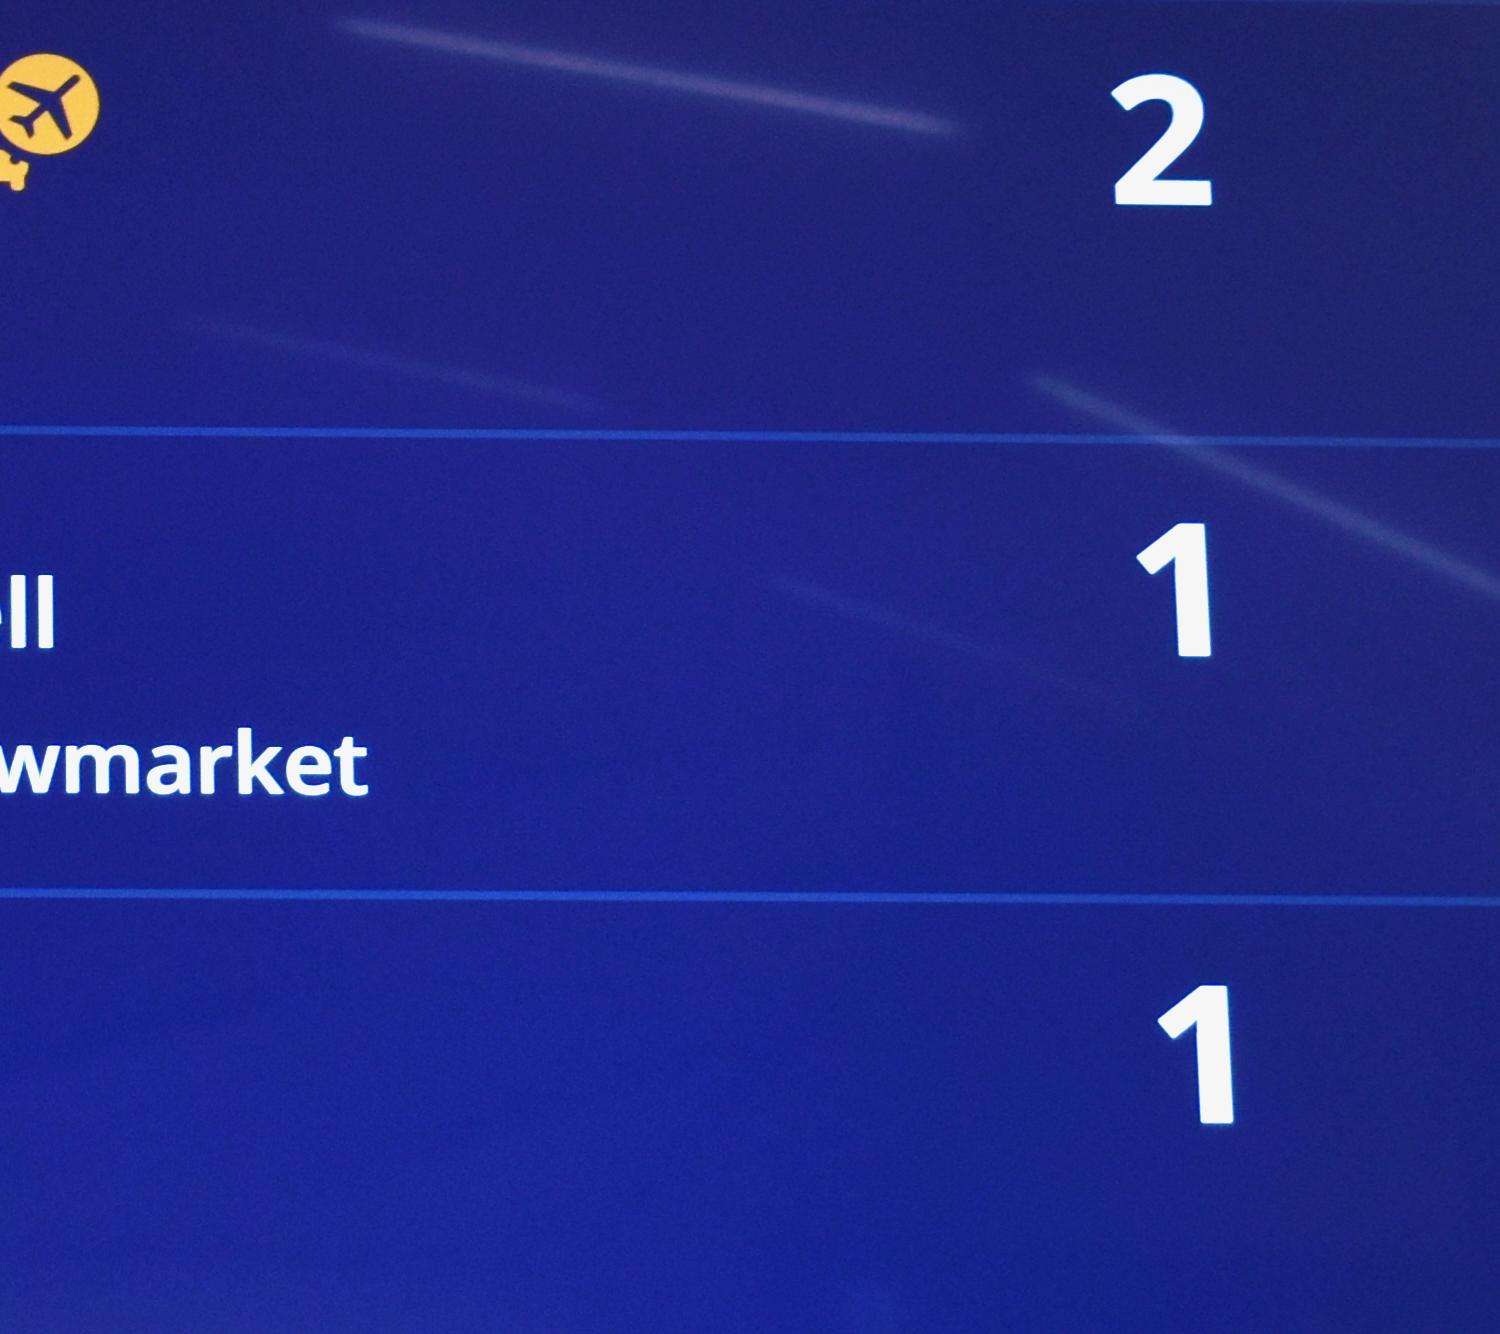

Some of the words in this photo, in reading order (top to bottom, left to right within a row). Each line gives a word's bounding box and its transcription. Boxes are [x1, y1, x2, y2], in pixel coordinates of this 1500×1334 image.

[1110, 72, 1214, 207] 2
[1135, 521, 1213, 659] 1
[1156, 983, 1236, 1126] 1
